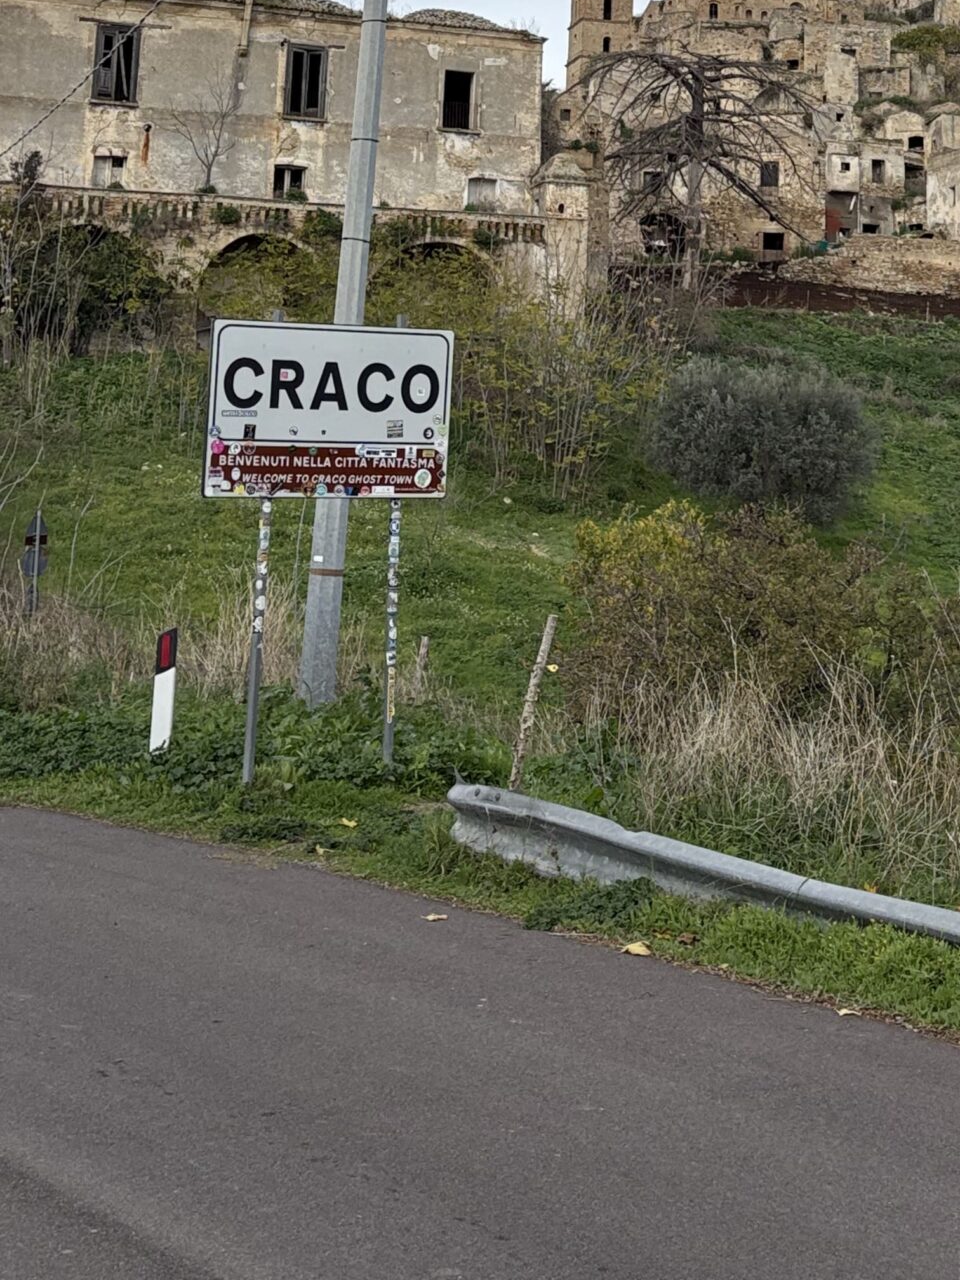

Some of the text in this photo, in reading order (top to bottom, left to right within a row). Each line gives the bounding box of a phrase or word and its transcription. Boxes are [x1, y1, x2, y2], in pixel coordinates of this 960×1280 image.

[224, 357, 439, 413] CRACO
[219, 455, 290, 468] BENVENUTI
[293, 456, 331, 468] NELLA
[372, 457, 435, 469] FANTASMA
[241, 473, 412, 485] WELCOME TO CRACO GHOST TOWN
